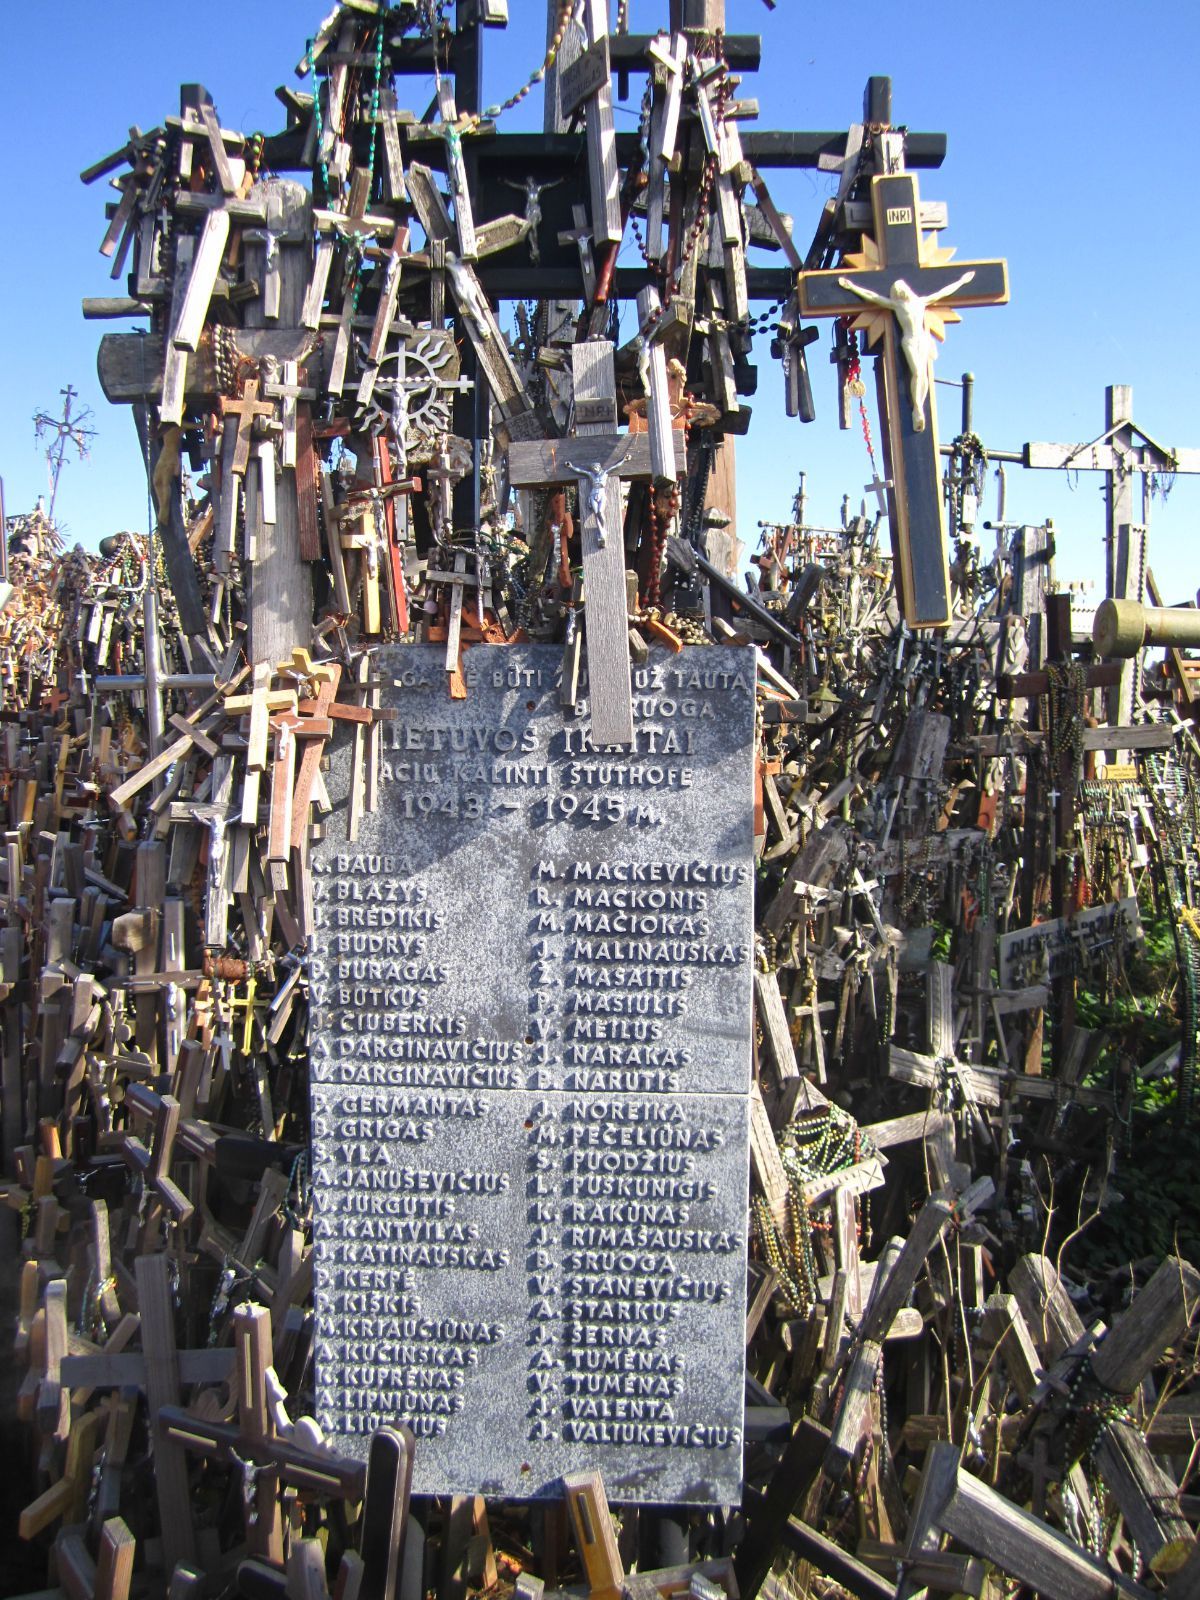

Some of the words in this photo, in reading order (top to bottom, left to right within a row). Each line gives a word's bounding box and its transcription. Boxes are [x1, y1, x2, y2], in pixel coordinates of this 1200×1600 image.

[888, 209, 910, 223] INRI
[635, 666, 665, 690] UŽ
[630, 698, 714, 719] RUOGA
[383, 725, 539, 752] IETUVOS
[378, 761, 440, 784] ACIŲ
[451, 763, 551, 784] KALINTI
[570, 761, 693, 786] ŠTUTHOFE
[403, 792, 484, 821] 1943
[544, 793, 625, 822] 1945
[337, 854, 412, 874] BAUBA
[573, 860, 749, 884] MACKEVIČIUS
[573, 910, 710, 936] MAČIOKAS
[338, 934, 427, 955] BUDRYS
[574, 940, 750, 962] MALINAUSKAS
[339, 961, 449, 982] BURAGAS
[340, 987, 428, 1007] BUTKUS
[573, 993, 688, 1015] MASIULIS
[340, 1009, 467, 1034] ČIUBERKIS
[573, 1018, 662, 1040] MEILUS
[340, 1037, 523, 1060] DARGINAVIČIUS
[573, 1045, 692, 1066] NARAKAS
[340, 1063, 524, 1087] DARGINAVIČIUS
[573, 1071, 680, 1092] NARUTIS
[342, 1095, 489, 1116] GERMANTAS
[573, 1101, 687, 1121] NOREIKA
[341, 1119, 434, 1139] GRIGAS
[573, 1123, 724, 1149] PEČELIŪNAS
[342, 1143, 391, 1164] YLA
[573, 1150, 696, 1173] PUODŽIUS
[342, 1166, 510, 1192] JANUŠEVIČIUS
[343, 1195, 456, 1217] JURGUTIS
[572, 1201, 690, 1224] RAKŪNAS
[343, 1219, 480, 1242] KANTVILAS
[572, 1226, 744, 1249] RIMAŠAUSKAS
[343, 1243, 510, 1268] KATINAUSKAS
[571, 1252, 676, 1273] SRUOGA
[343, 1267, 416, 1290] KERPĖ
[571, 1275, 732, 1299] STANEVIČIUS
[344, 1291, 422, 1314] KIŠKIS
[571, 1301, 681, 1321] STARKUS
[344, 1317, 505, 1341] KRIAUČIŪNAS
[571, 1321, 666, 1347] ŠERNAS
[571, 1349, 685, 1372] TUMĖNAS
[345, 1366, 465, 1389] KUPRĖNAS
[571, 1373, 684, 1396] TUMĖNAS
[345, 1389, 465, 1412] LIPNIŪNAS
[570, 1398, 674, 1419] VALENTA
[345, 1411, 447, 1435] LIUIUS
[570, 1422, 742, 1448] VALIUKEVIČIUS
